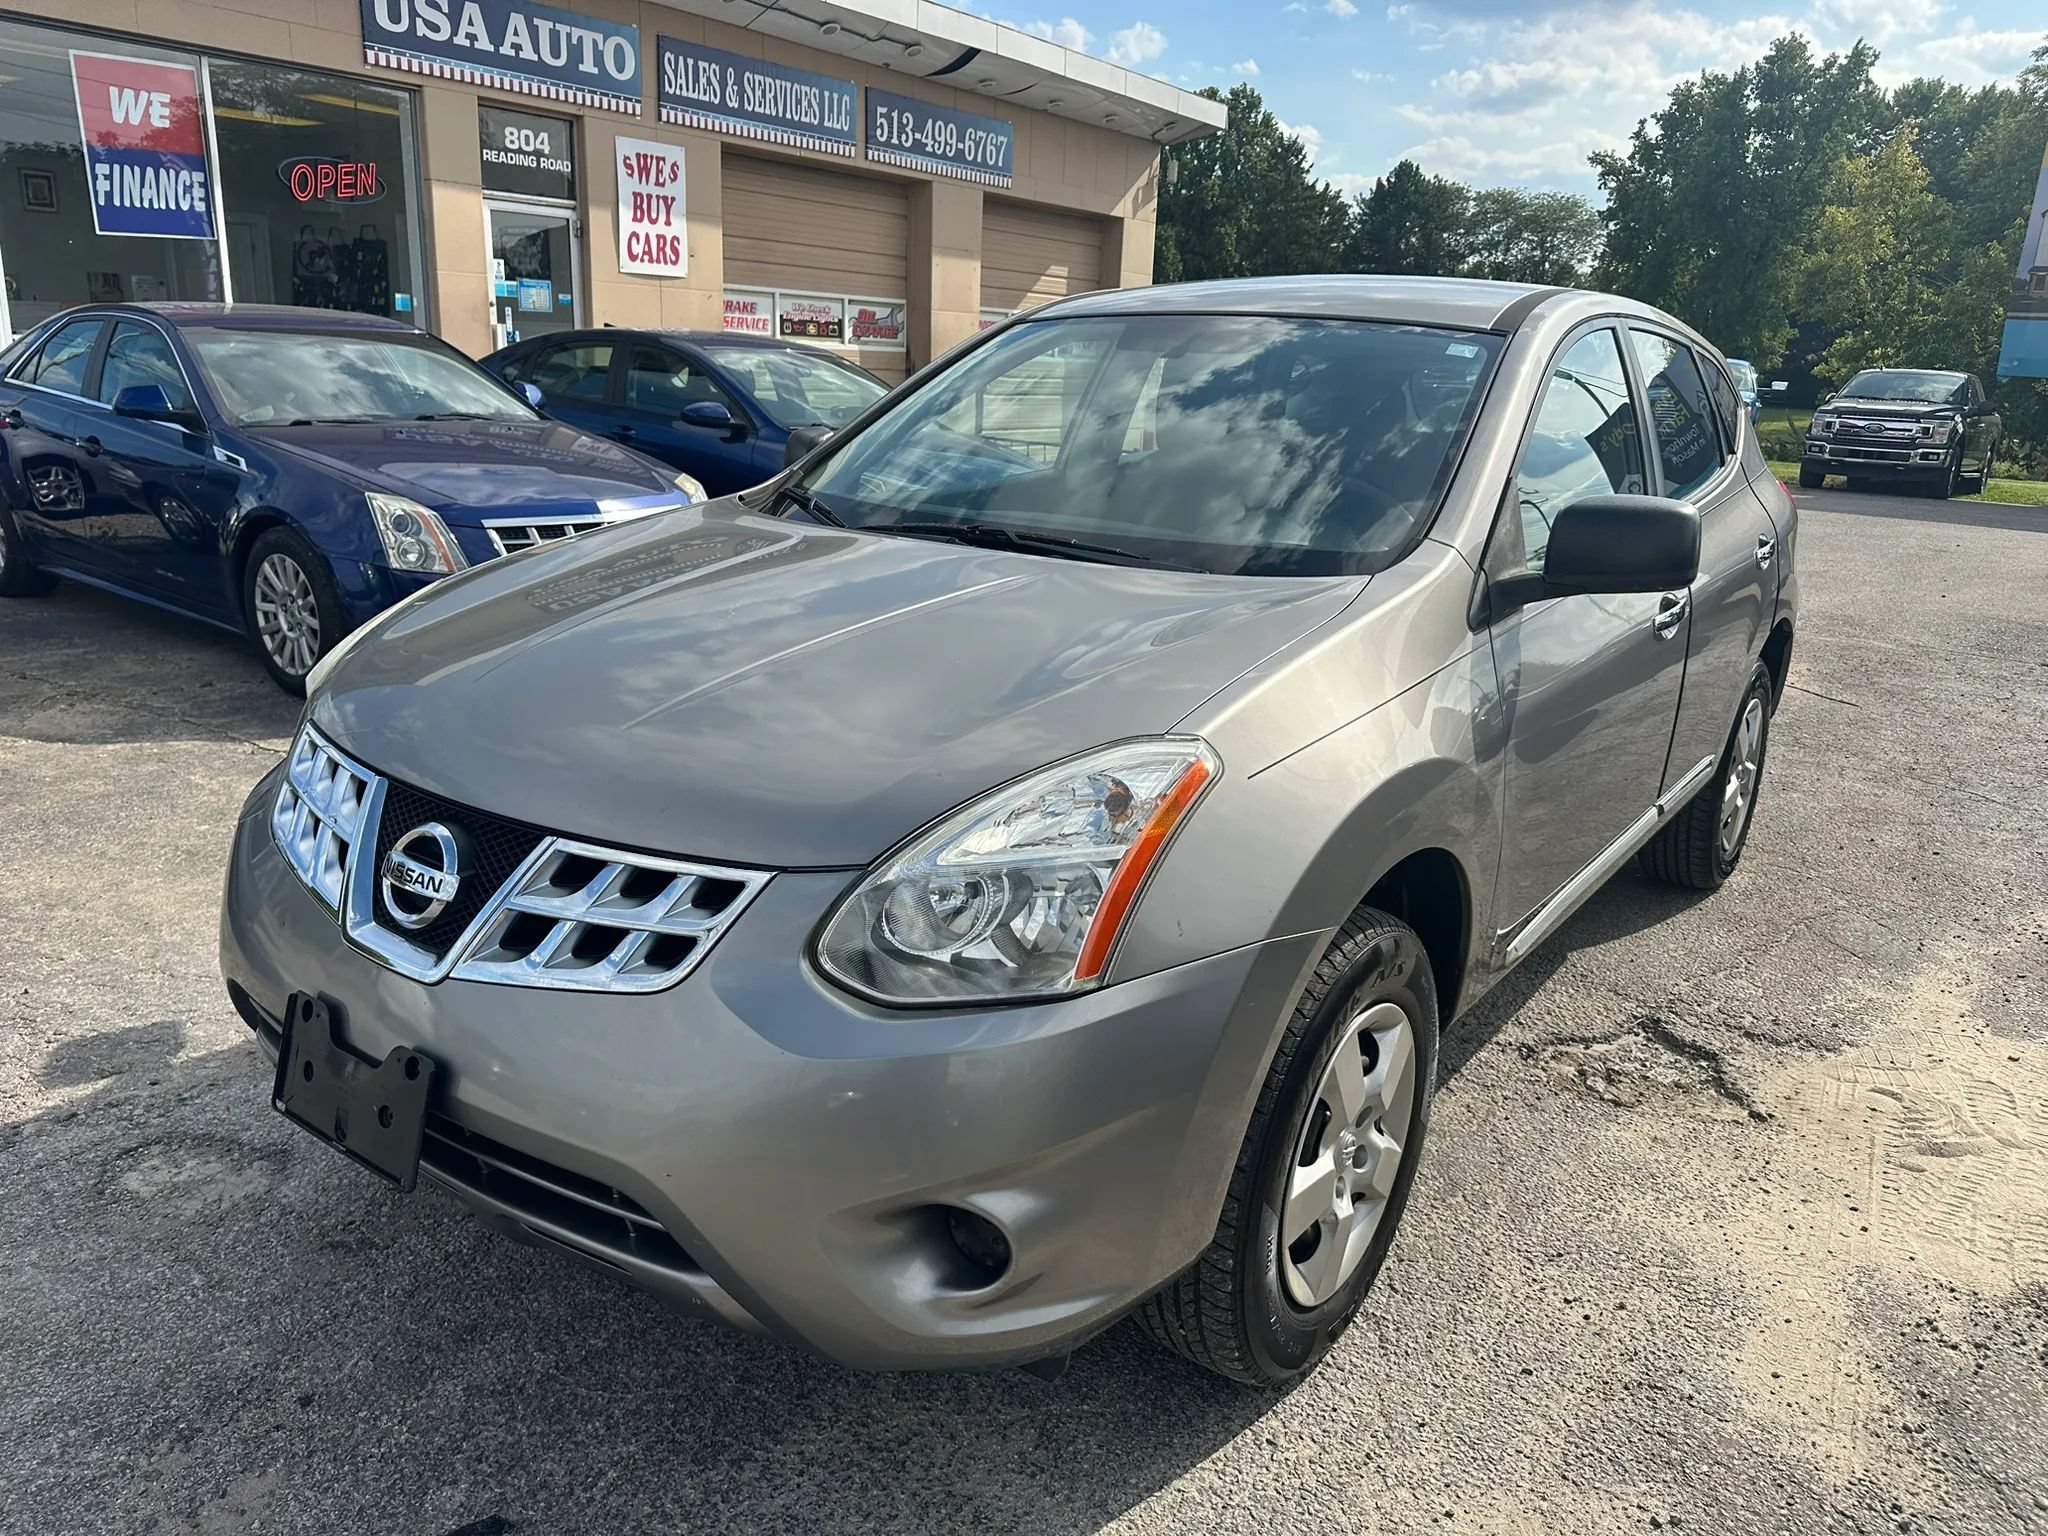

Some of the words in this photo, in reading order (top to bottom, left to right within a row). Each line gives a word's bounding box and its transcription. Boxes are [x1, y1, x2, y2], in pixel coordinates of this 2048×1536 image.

[374, 0, 494, 52] USA
[500, 12, 637, 81] AUTO
[109, 86, 171, 128] WE
[664, 51, 721, 105] SALES
[725, 67, 739, 109] &
[743, 71, 820, 126] SERVICES
[823, 91, 850, 132] LLC
[504, 126, 551, 154] 804
[876, 106, 1008, 167] 513-499-6767
[483, 149, 537, 168] READING
[540, 156, 572, 173] ROAD
[95, 163, 206, 212] FINANCE
[291, 163, 377, 201] OPEN
[631, 192, 676, 227] BUY
[627, 231, 681, 266] CARS
[723, 300, 758, 314] RAKE
[723, 315, 769, 331] SERVICE
[383, 857, 443, 894] NISSAN
[1370, 962, 1406, 991] A/S
